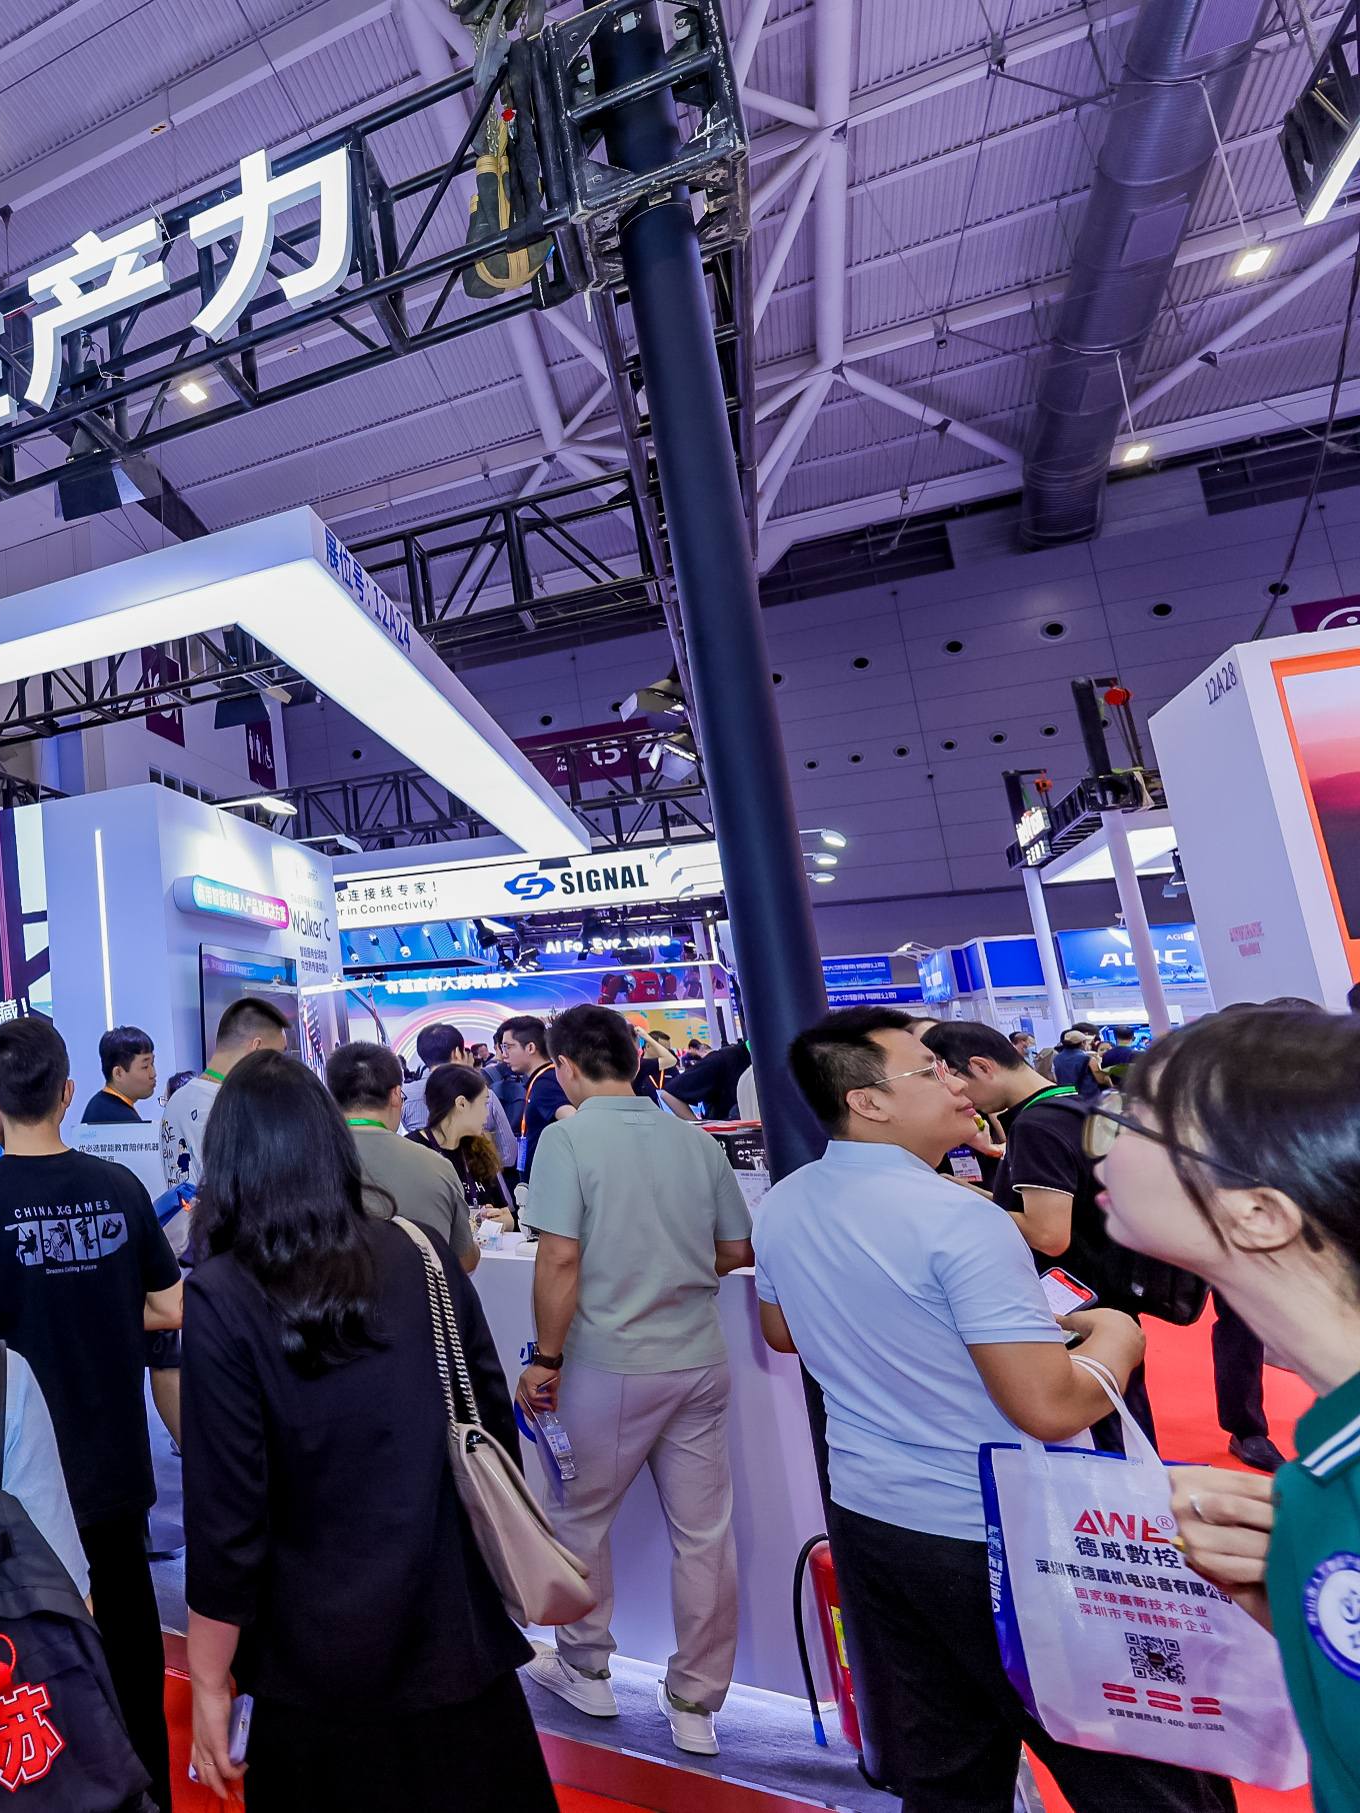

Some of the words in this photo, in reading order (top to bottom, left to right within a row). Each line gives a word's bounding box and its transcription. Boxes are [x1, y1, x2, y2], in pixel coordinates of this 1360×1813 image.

[1205, 661, 1237, 705] 12A28
[561, 863, 649, 895] SIGNAL
[346, 906, 357, 916] in
[360, 897, 438, 915] Connectivity!
[290, 909, 323, 938] Walker
[324, 917, 331, 942] C
[545, 940, 561, 954] AI
[564, 940, 589, 954] Fo
[593, 934, 672, 951] Eveyone
[14, 1206, 53, 1219] CHINA
[1074, 1536, 1184, 1569] 德威數控
[1074, 1587, 1209, 1618] 国家级高新技术企业
[1079, 1603, 1214, 1635] 深圳市专精特新企业
